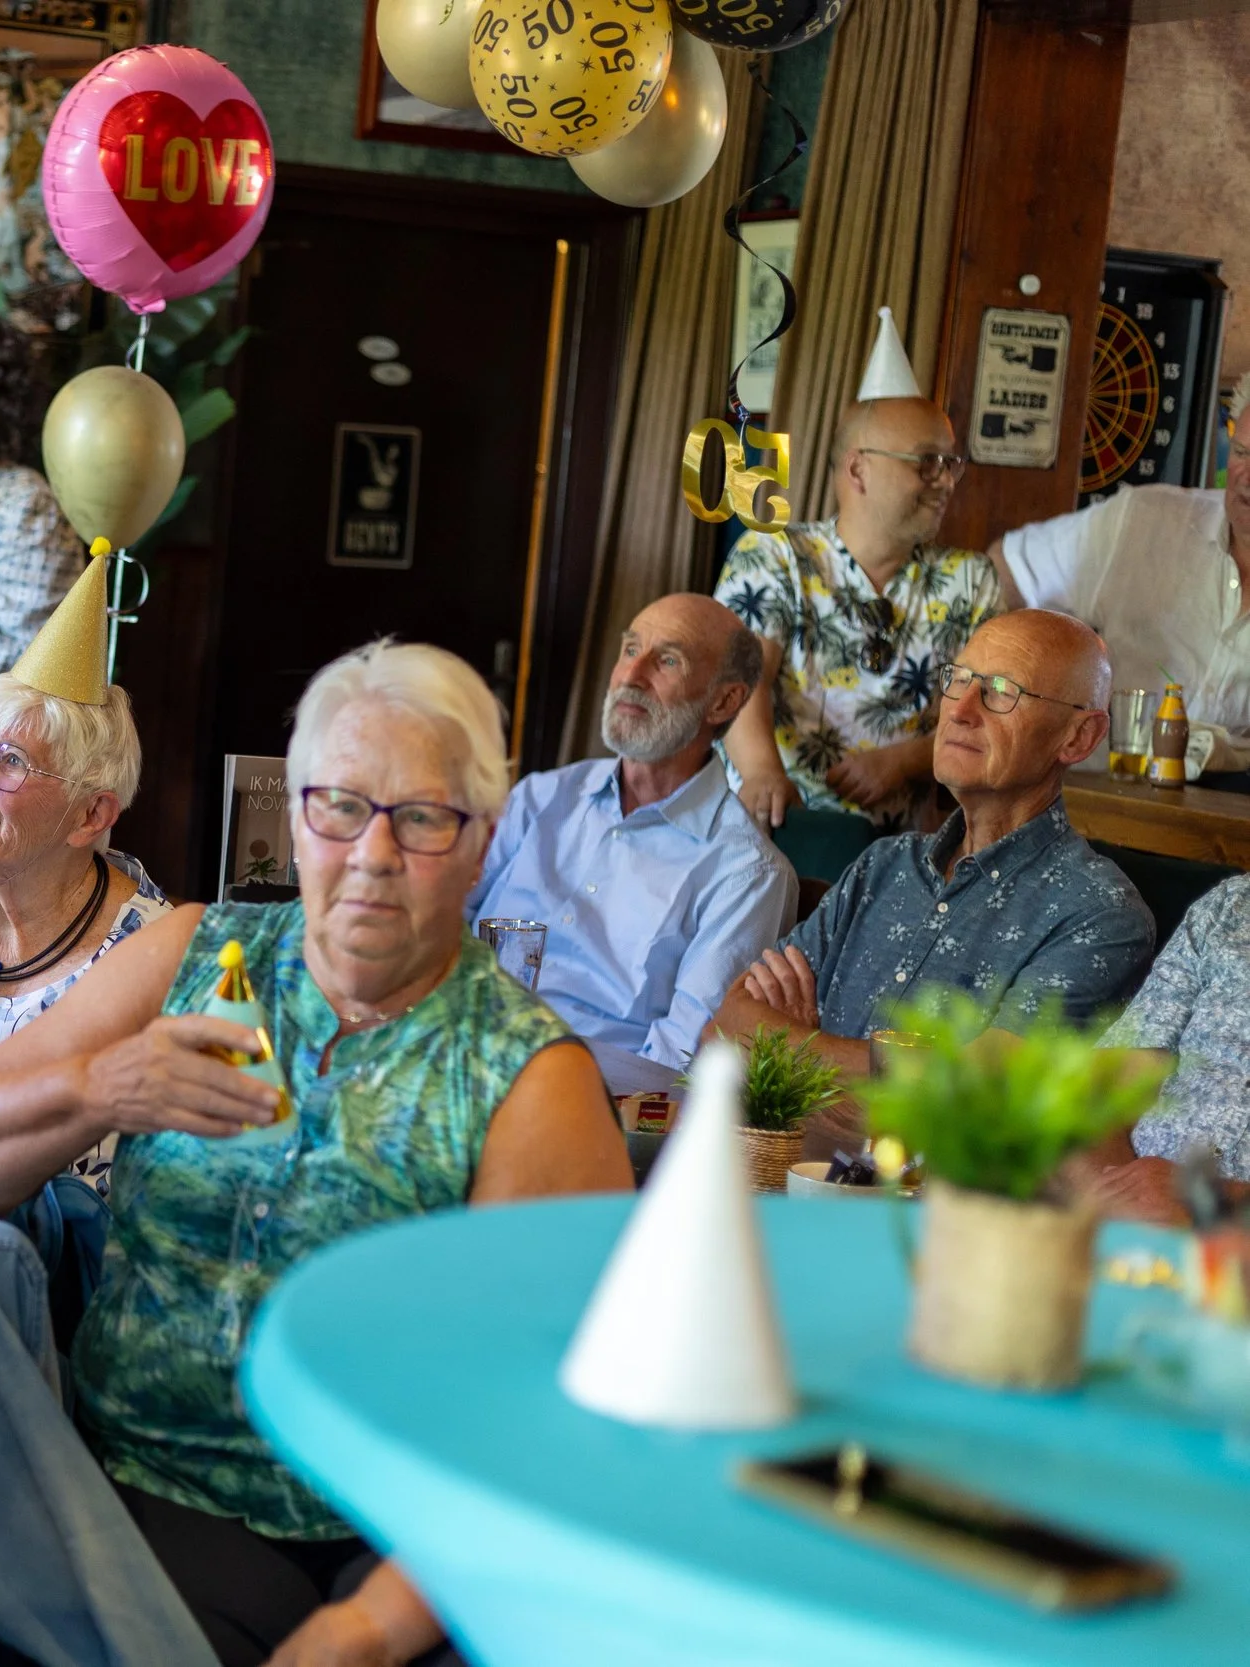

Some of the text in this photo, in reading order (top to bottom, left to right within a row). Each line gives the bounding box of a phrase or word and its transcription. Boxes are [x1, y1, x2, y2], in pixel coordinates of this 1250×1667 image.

[474, 10, 509, 53] 50
[522, 0, 574, 49] 50
[590, 21, 636, 74] 50
[500, 73, 538, 119] 50
[550, 96, 598, 136] 50
[628, 79, 663, 114] 50
[124, 134, 262, 206] LOVE
[990, 321, 1060, 341] GENTLEMEN
[988, 387, 1048, 410] LADIES
[250, 775, 288, 793] IK MA
